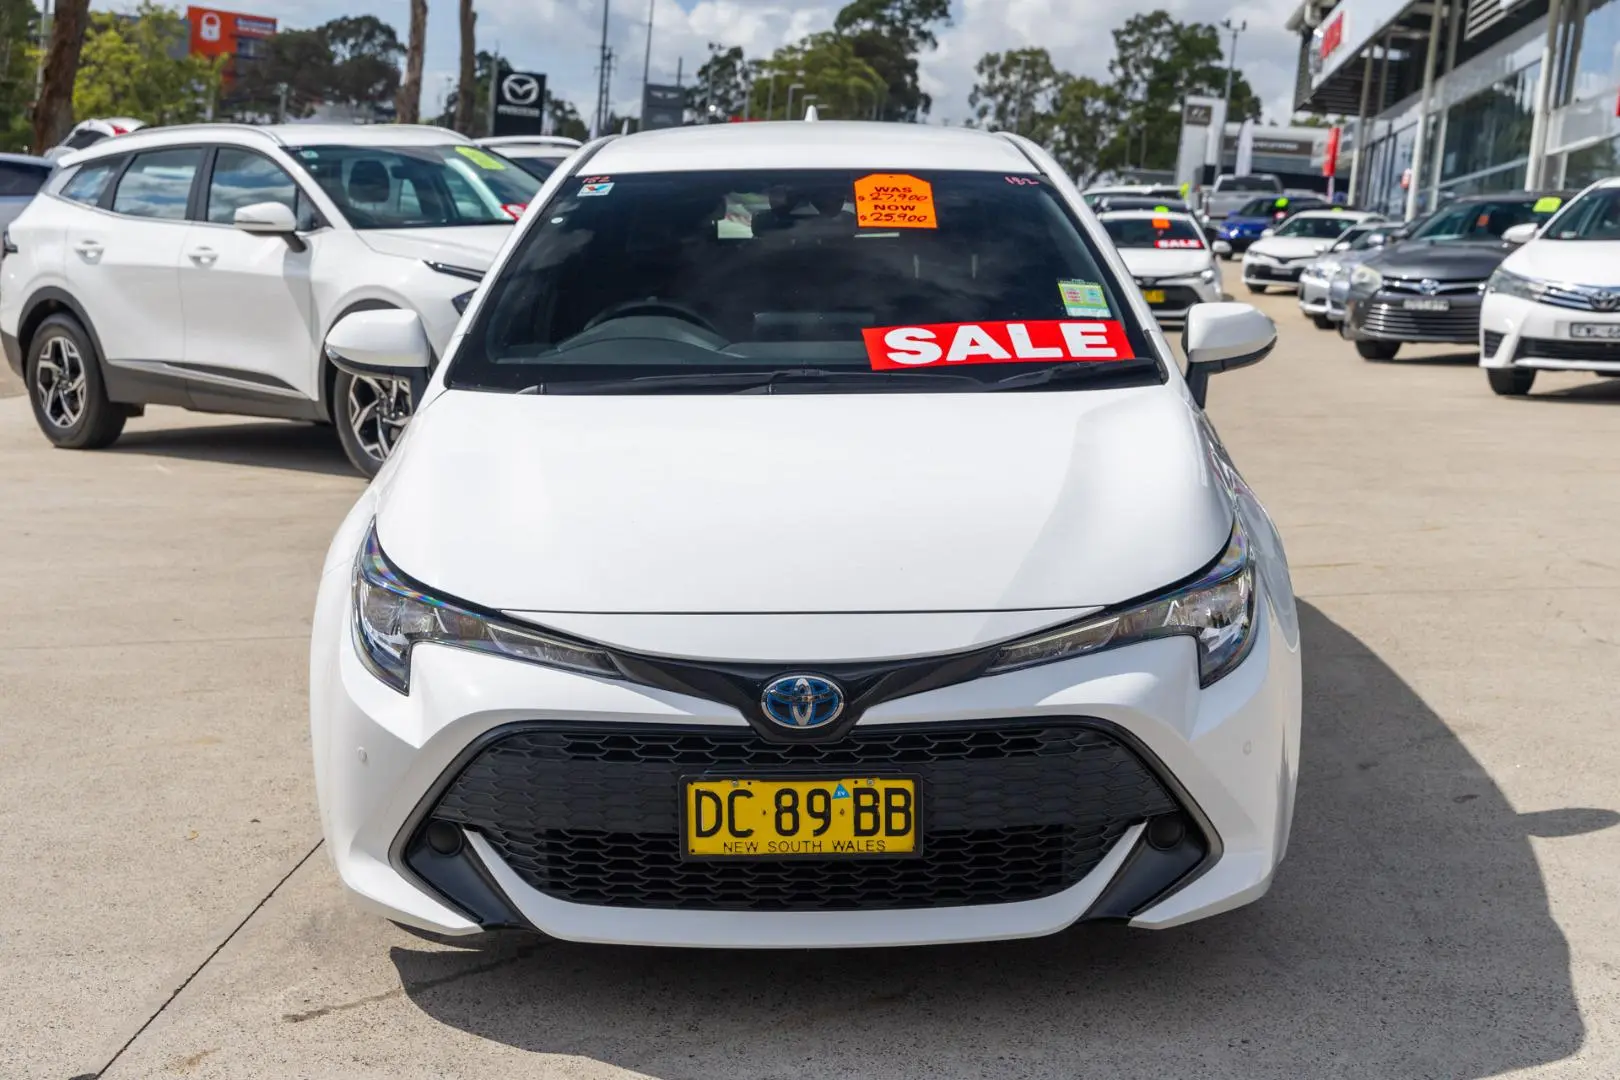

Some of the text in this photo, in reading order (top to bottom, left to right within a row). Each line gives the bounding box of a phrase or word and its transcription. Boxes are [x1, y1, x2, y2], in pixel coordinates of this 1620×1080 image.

[884, 322, 1118, 365] SALE
[695, 788, 912, 838] DC 89 BB
[723, 839, 886, 853] NEW SOUTH WALES
